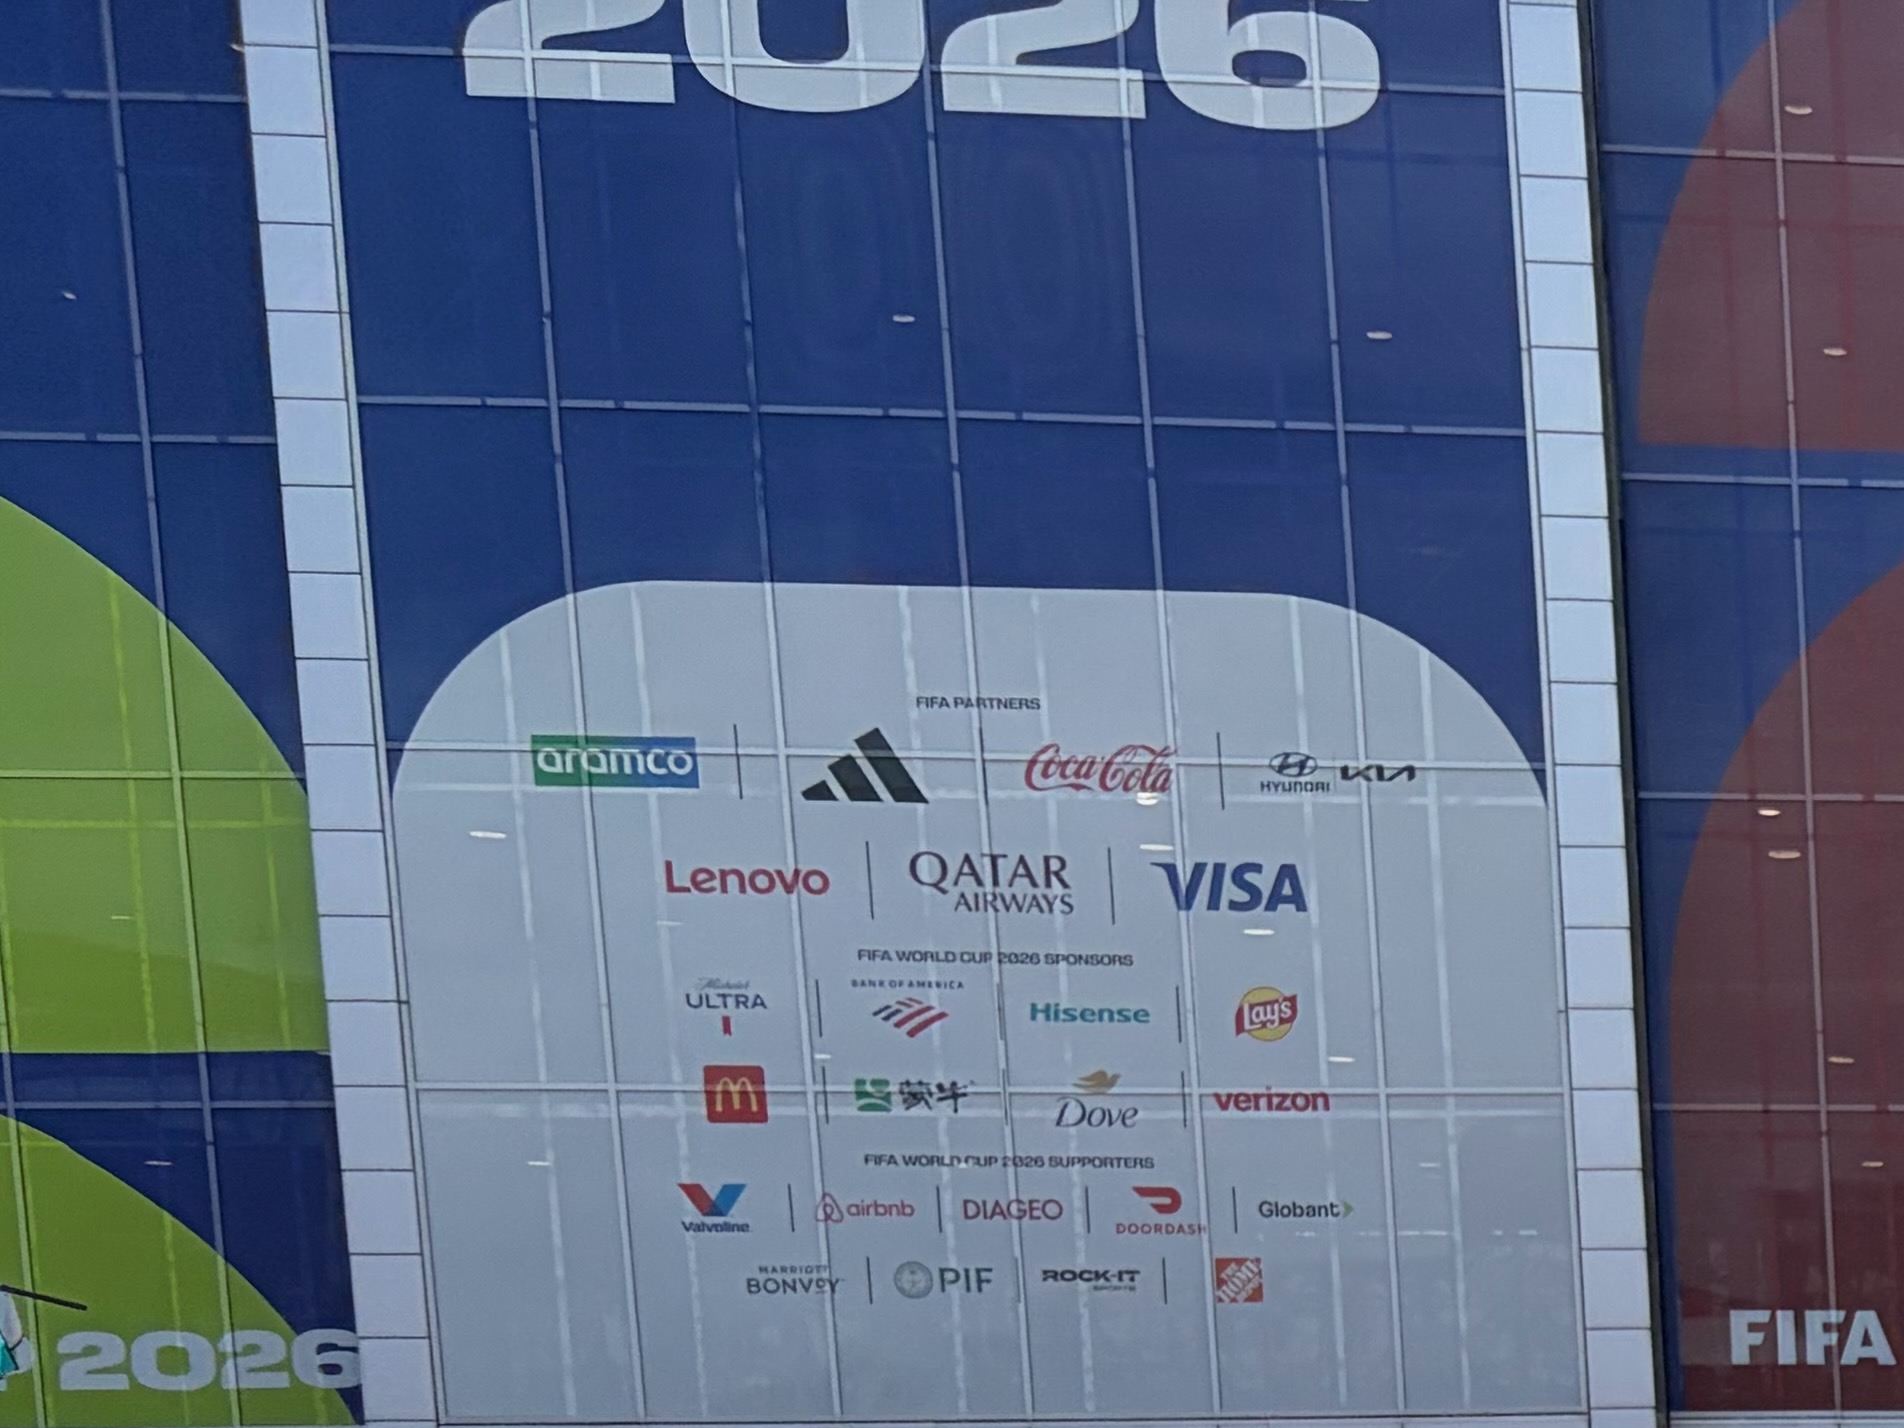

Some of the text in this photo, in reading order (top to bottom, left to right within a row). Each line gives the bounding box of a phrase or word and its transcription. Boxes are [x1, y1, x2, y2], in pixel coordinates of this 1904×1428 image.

[462, 0, 1382, 130] 2026
[915, 696, 1042, 711] FIFA PARTNERS
[537, 746, 695, 776] aramco
[1259, 780, 1331, 793] HYUNDAI
[664, 860, 831, 896] Lenovo
[908, 851, 1072, 894] QATAR
[1150, 862, 1309, 913] VISA
[954, 893, 1075, 915] AIRWAYS
[857, 948, 1134, 967] FIFA WORLD CUP 2026 SPONSORS
[851, 978, 965, 990] BANK OF AMERICA
[685, 993, 768, 1010] ULTRA
[1030, 1002, 1151, 1024] Hisense
[1213, 1086, 1331, 1112] verizon
[1055, 1095, 1139, 1128] Dove
[864, 1154, 1155, 1169] FIFA WORLD CUP 2026 SUPPORTERS
[846, 1200, 915, 1218] airbnb
[962, 1198, 1064, 1221] DIAGEO
[1258, 1201, 1341, 1218] Globant
[681, 1220, 751, 1233] Valvoline
[1115, 1223, 1207, 1235] DOORDASH
[757, 1265, 829, 1275] MARRIOTT
[938, 1266, 994, 1293] PIF
[1042, 1269, 1141, 1283] ROCK-IT
[746, 1277, 840, 1295] BONVOY
[1728, 1308, 1896, 1367] FIFA
[56, 1328, 361, 1392] 2026
